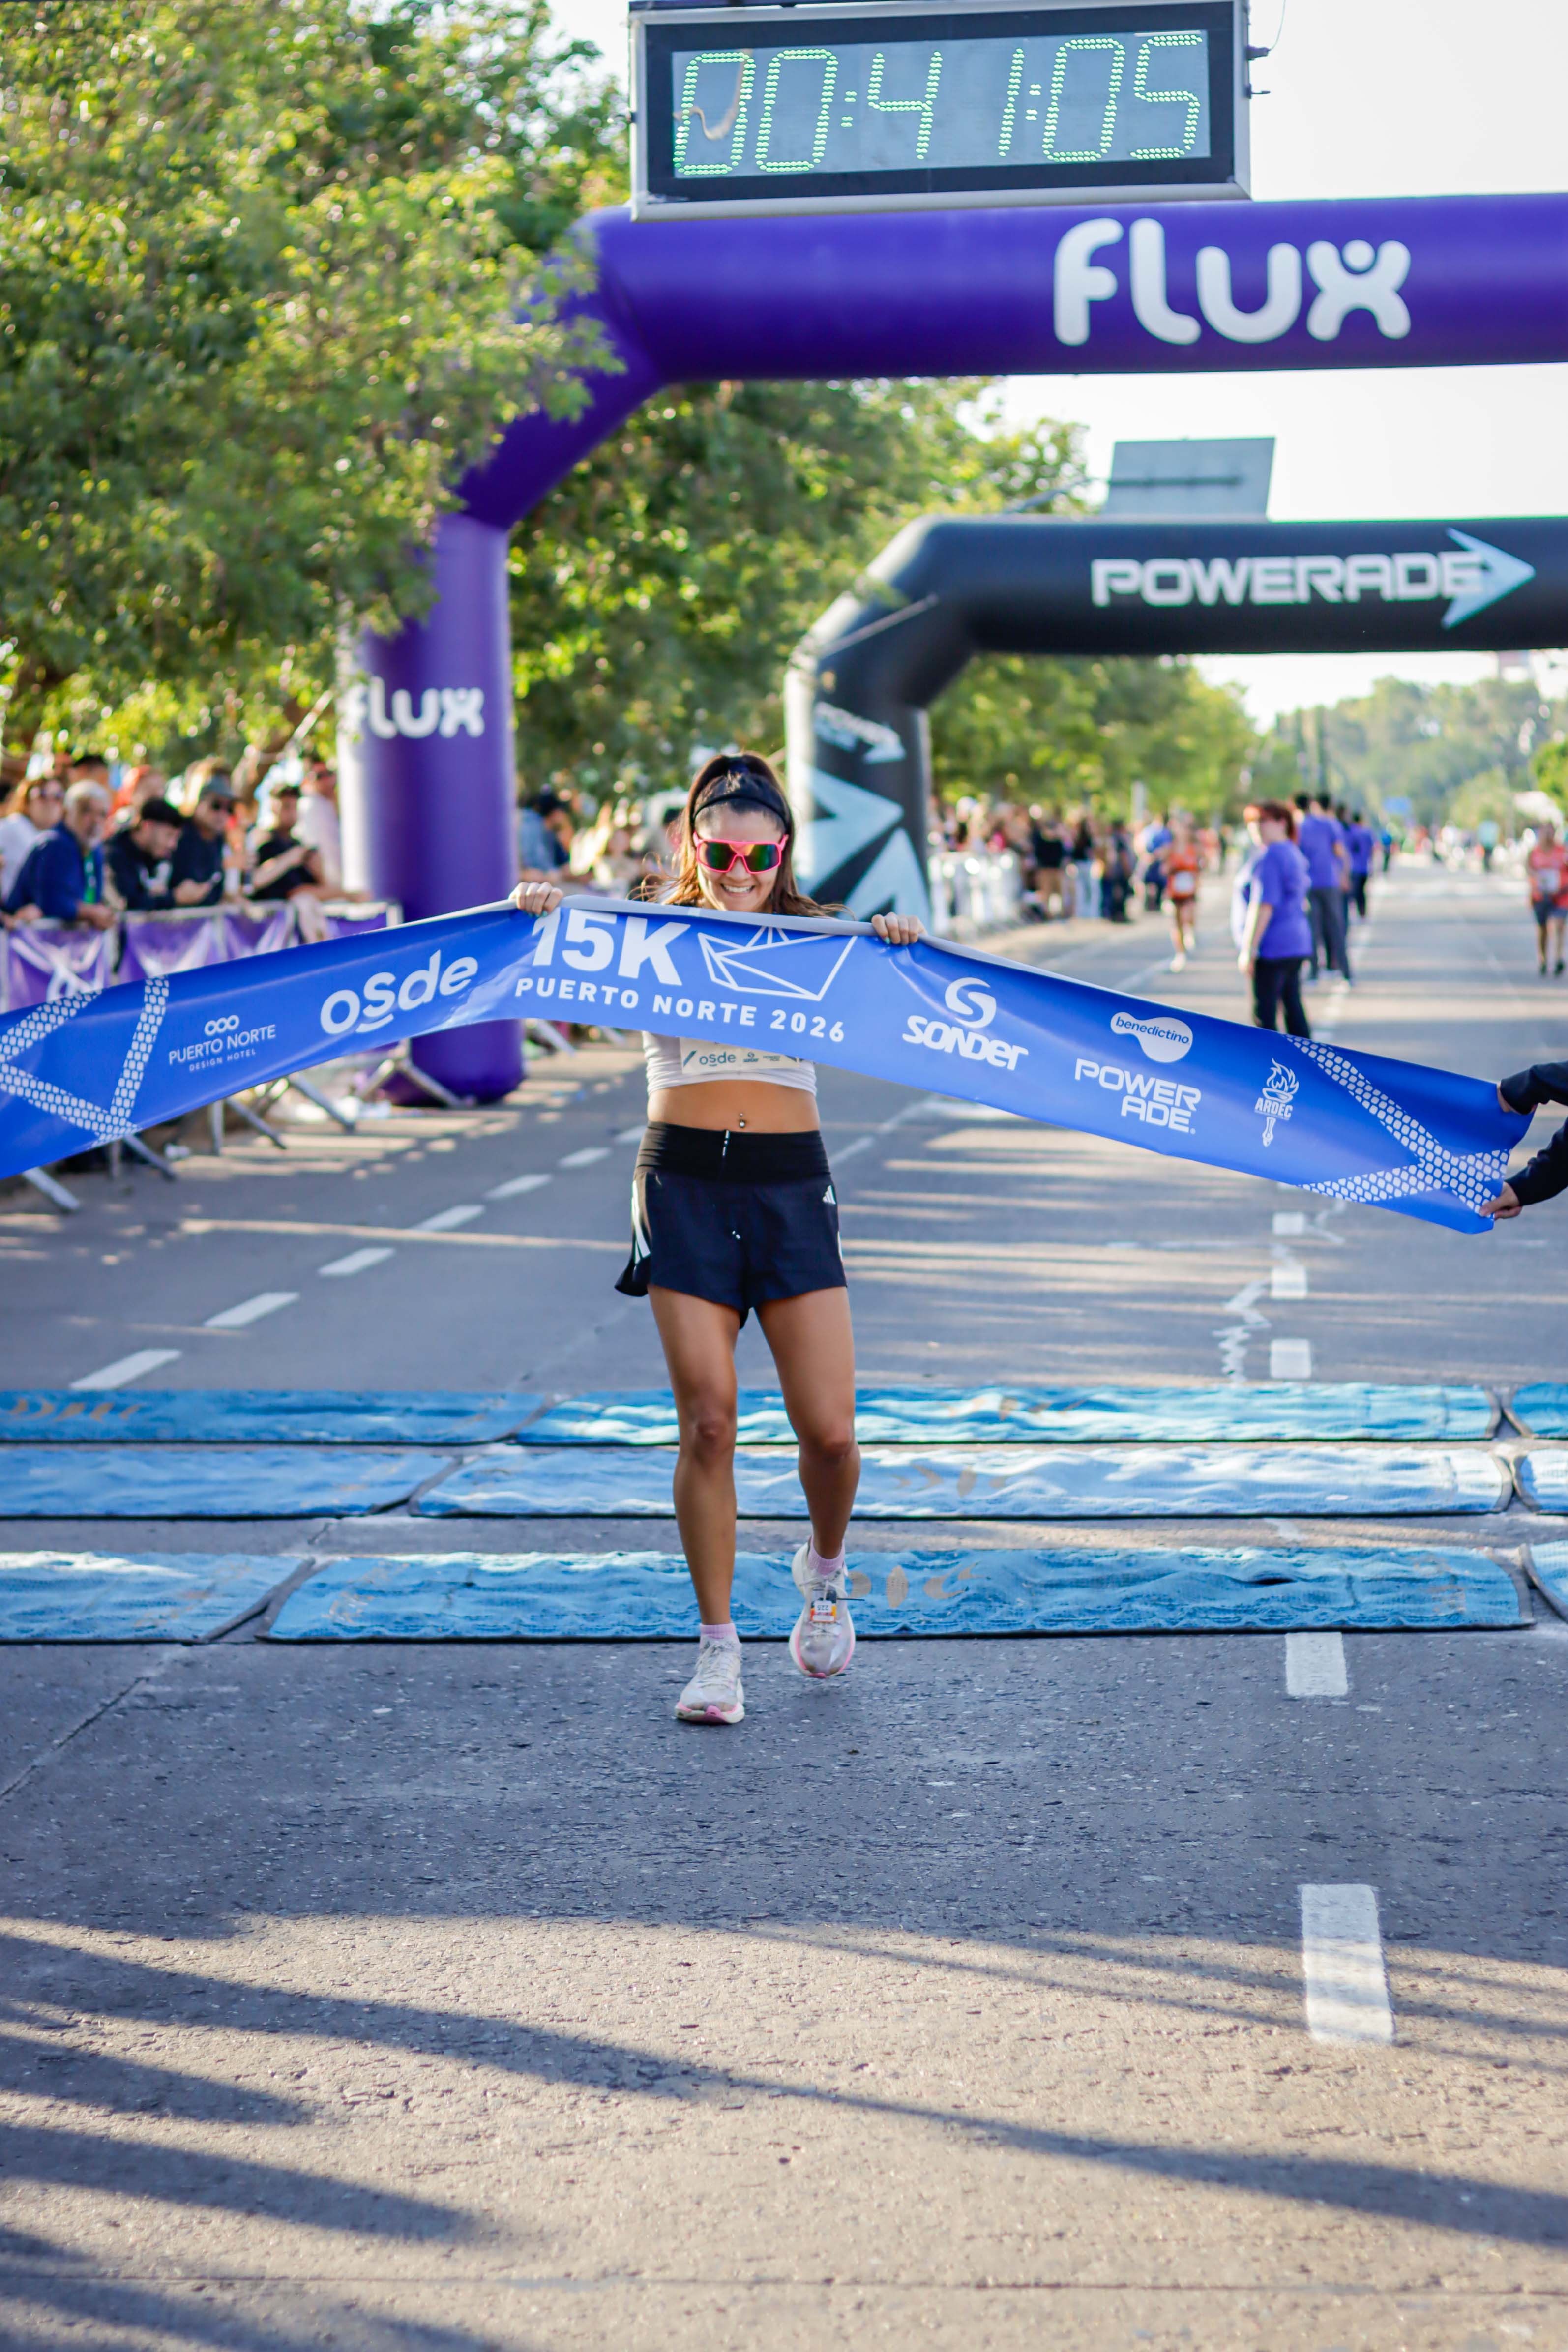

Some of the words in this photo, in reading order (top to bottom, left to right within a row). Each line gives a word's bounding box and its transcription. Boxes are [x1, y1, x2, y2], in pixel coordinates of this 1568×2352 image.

[673, 34, 1203, 175] 00:41:05
[1091, 550, 1485, 607] POWERADE
[531, 907, 691, 986] 15K
[321, 949, 478, 1035] osde
[515, 977, 639, 1009] PUERTO
[652, 994, 757, 1026] NORTE
[770, 1009, 845, 1042] 2026
[169, 1038, 223, 1065] PUERTO
[227, 1024, 276, 1049] NORTE
[1115, 1016, 1190, 1044] benedictino
[189, 1056, 223, 1072] DESIGN
[227, 1048, 256, 1061] HOTEL
[699, 1051, 736, 1066] osde
[1075, 1058, 1201, 1111] POWER
[1255, 1097, 1293, 1118] ARDEC
